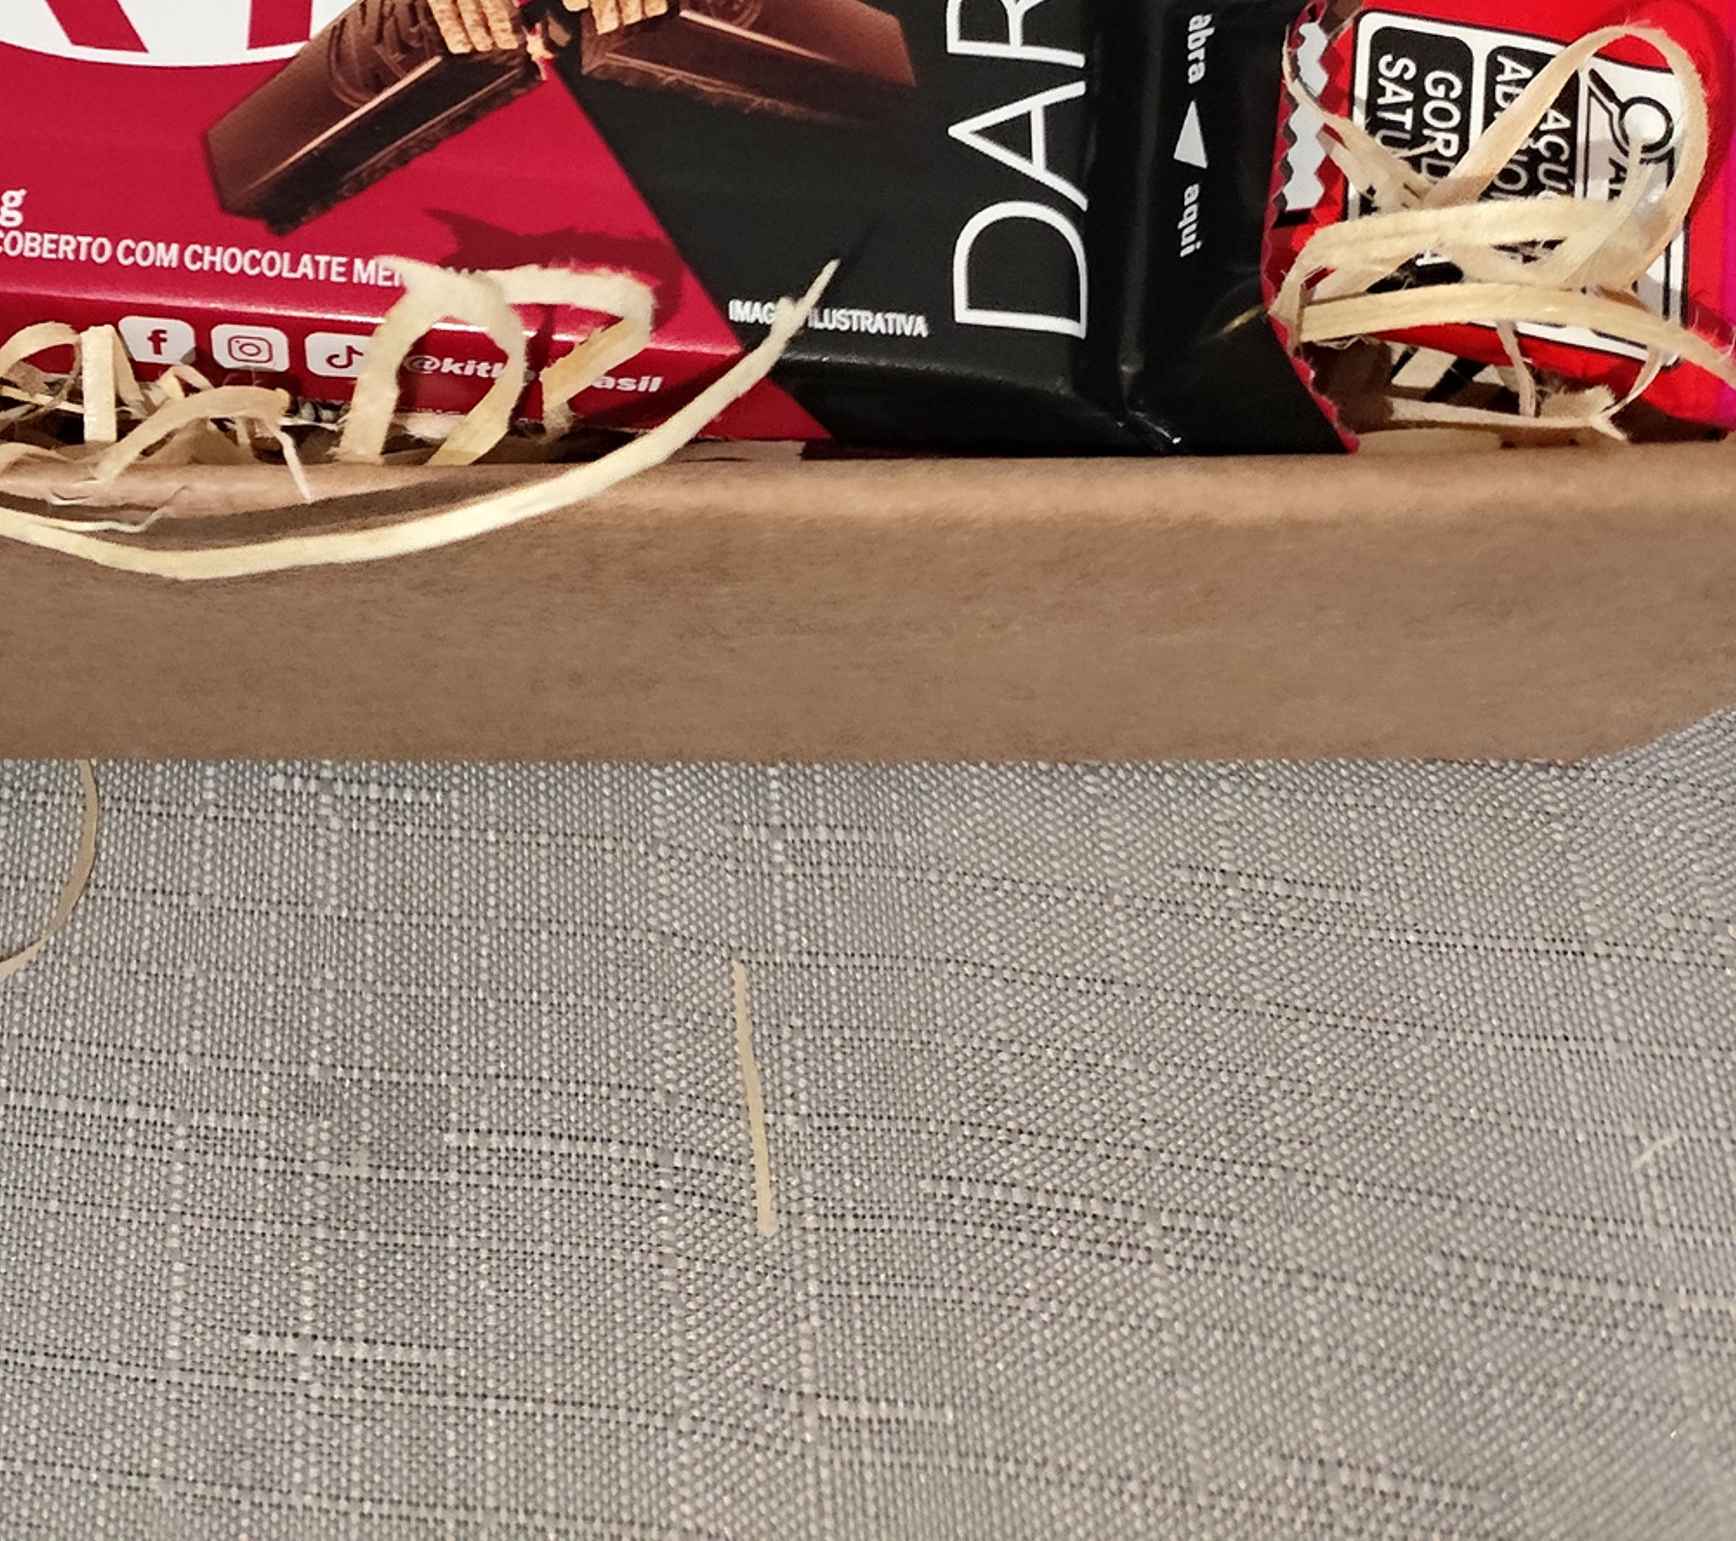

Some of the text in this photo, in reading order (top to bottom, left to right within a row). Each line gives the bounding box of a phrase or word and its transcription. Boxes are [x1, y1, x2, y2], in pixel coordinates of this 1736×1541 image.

[1186, 13, 1214, 85] abra
[0, 187, 27, 227] g
[1176, 181, 1203, 259] aqui
[116, 238, 179, 268] COM
[183, 244, 348, 283] CHOCOLATE
[352, 258, 402, 287] MEI
[728, 299, 930, 338] IMAG ILUSTRATIVA
